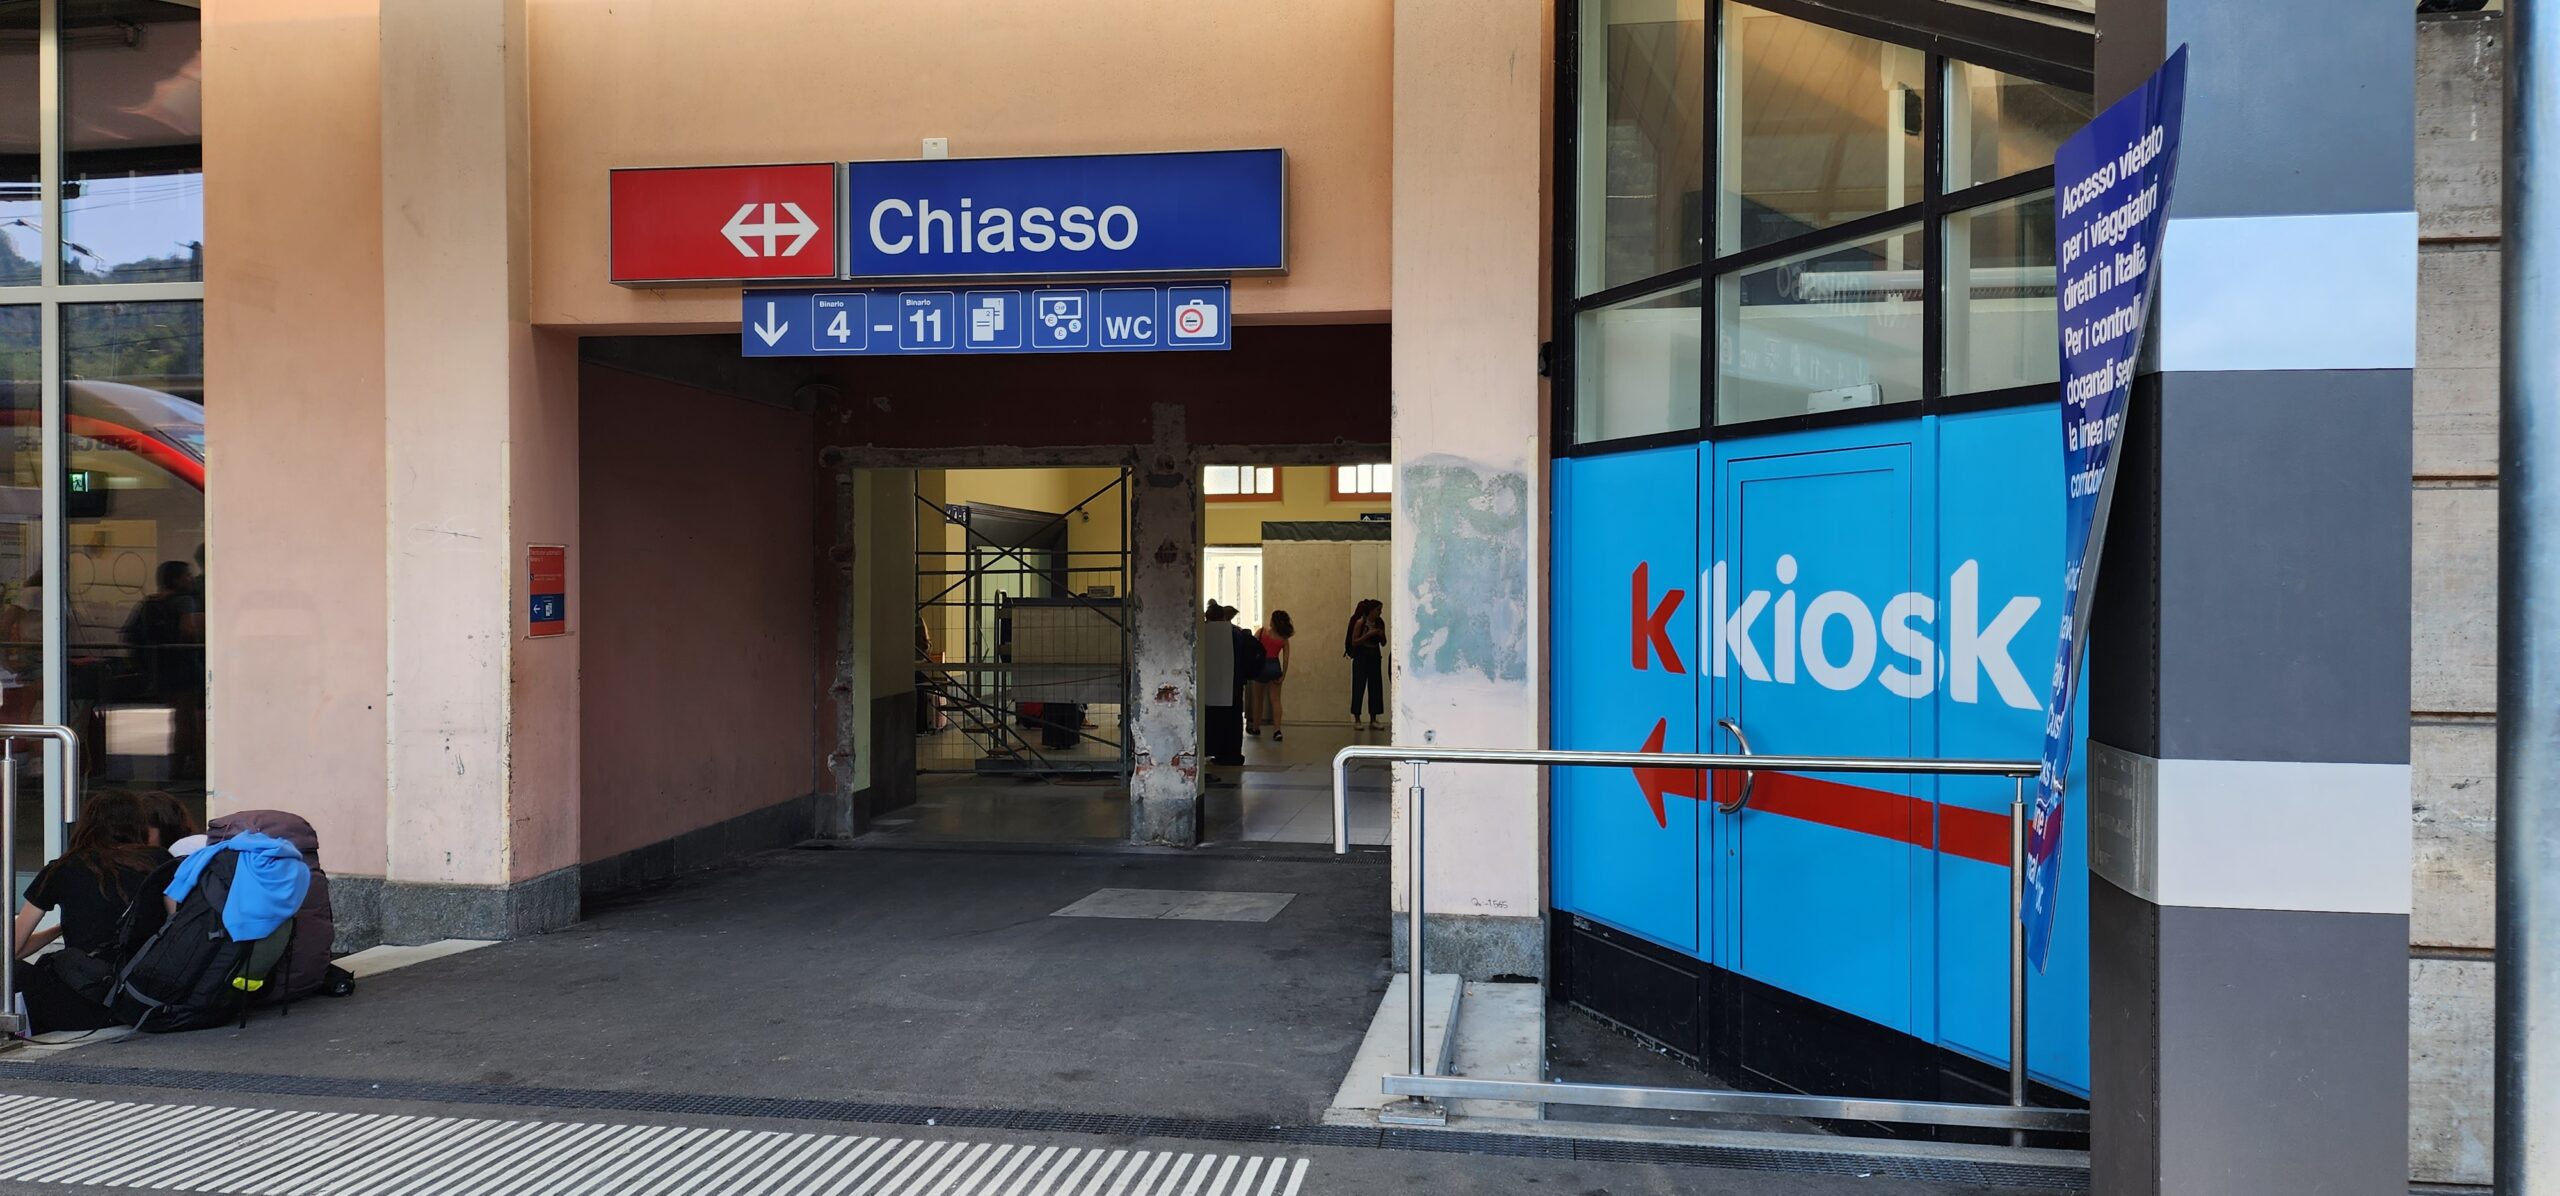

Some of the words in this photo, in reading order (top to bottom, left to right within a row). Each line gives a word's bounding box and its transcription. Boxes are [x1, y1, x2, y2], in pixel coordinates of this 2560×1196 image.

[2062, 161, 2116, 219] Accesso
[2119, 125, 2164, 180] vietato
[868, 198, 1139, 254] Chiasso
[2063, 230, 2083, 273] per
[2084, 220, 2089, 252] i
[2090, 174, 2158, 246] viaggiatori
[819, 300, 844, 308] Binario
[906, 299, 931, 307] Binario
[2064, 264, 2097, 312] diretti
[2099, 261, 2112, 294] in
[827, 310, 851, 343] 4
[909, 309, 941, 342] 11
[1105, 316, 1152, 340] WC
[2065, 327, 2083, 359] Per
[2085, 319, 2089, 350] i
[2066, 358, 2113, 409] doganali
[2068, 421, 2078, 452] la
[2079, 418, 2103, 447] linea
[1632, 561, 1687, 674] k
[1701, 554, 2044, 711] kiosk
